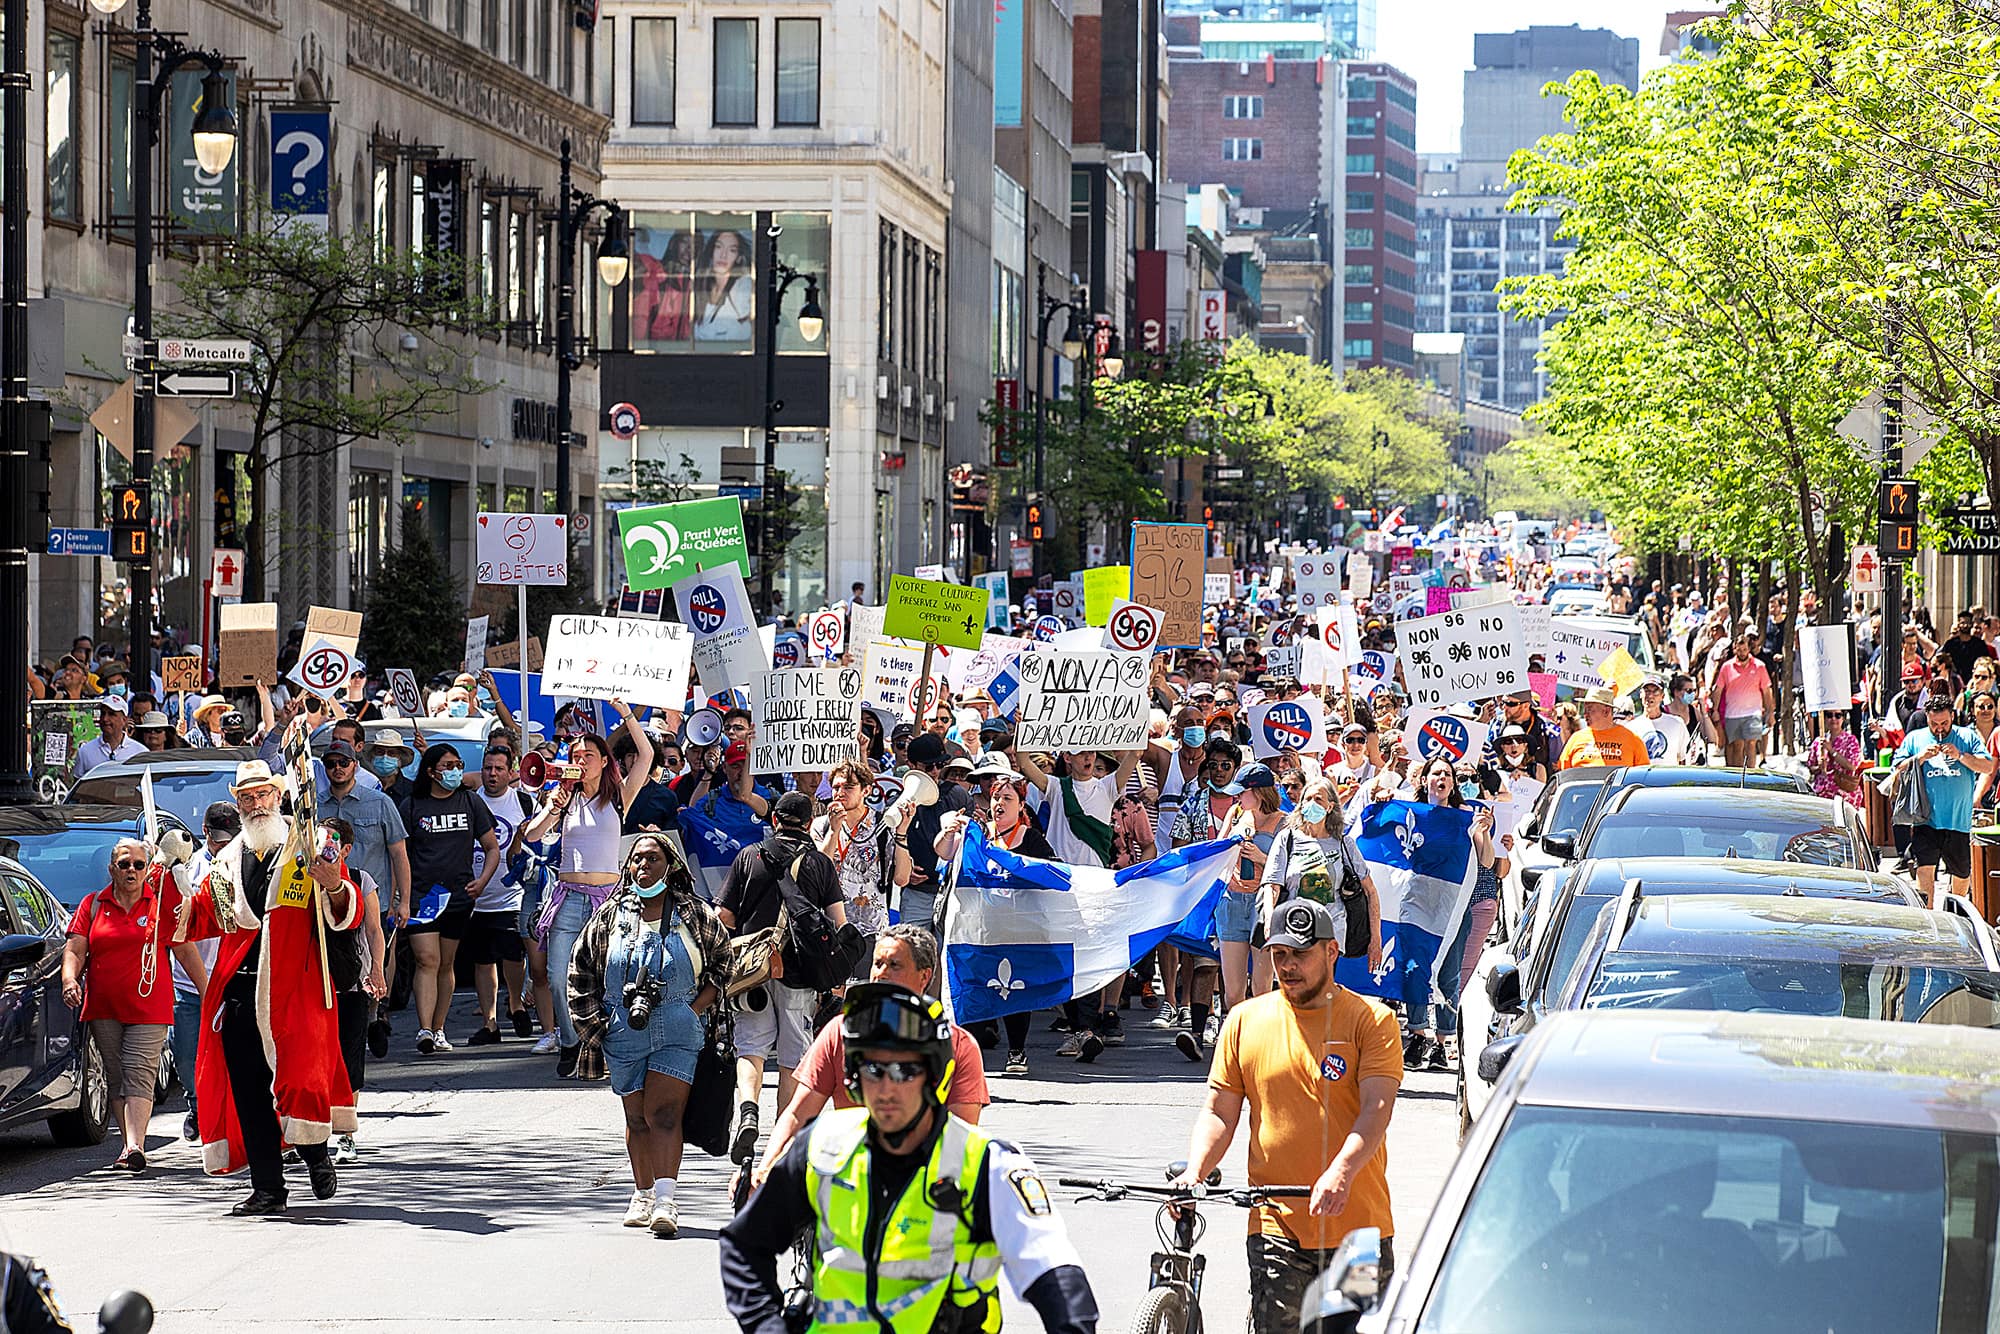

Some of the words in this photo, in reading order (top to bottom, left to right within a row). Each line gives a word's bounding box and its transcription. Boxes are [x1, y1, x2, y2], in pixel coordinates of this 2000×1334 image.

[184, 347, 246, 360] Metcalfe
[684, 530, 710, 542] Parti
[713, 524, 738, 537] Vert
[1137, 525, 1164, 552] I
[1165, 525, 1204, 551] GOT
[680, 542, 693, 551] du
[694, 536, 742, 552] Québec
[499, 562, 566, 582] BETTER
[1137, 553, 1192, 600] 96
[896, 580, 928, 594] VOTRE
[692, 589, 718, 607] BILL
[944, 600, 962, 612] SANS
[1135, 593, 1201, 621] PBLEMS
[1040, 619, 1060, 632] BILL
[1116, 613, 1151, 644] 96
[1444, 613, 1465, 628] 96
[1480, 617, 1503, 632] NO
[816, 621, 837, 642] 96
[1408, 627, 1440, 646] NON
[1551, 630, 1584, 647] CONTRE
[1585, 640, 1596, 650] LA
[491, 642, 537, 662] TEAH
[1478, 643, 1511, 660] NON
[167, 658, 199, 673] NON
[307, 654, 343, 684] 96
[881, 656, 888, 669] Is
[890, 656, 914, 673] there
[1042, 658, 1098, 690] NON
[1096, 653, 1119, 693] À
[1125, 659, 1144, 681] 96
[1421, 664, 1444, 679] NO
[184, 672, 200, 688] 96
[763, 673, 788, 700] LET
[795, 672, 826, 697] ME
[875, 675, 898, 687] room
[1450, 672, 1487, 691] NON
[1496, 670, 1515, 684] 96
[1572, 673, 1580, 682] LE
[394, 680, 417, 703] 96
[880, 690, 896, 703] ME
[897, 691, 906, 705] in
[1418, 689, 1440, 703] NO
[1022, 693, 1056, 722] LA
[1064, 691, 1141, 723] DIVISION
[1270, 708, 1306, 725] BILL
[763, 721, 789, 742] THE
[793, 721, 857, 741] LANGUAGE
[1020, 723, 1067, 748] DANS
[1273, 724, 1305, 749] 96
[1431, 719, 1464, 741] BILL
[755, 745, 785, 770] FOR
[776, 743, 796, 767] MY
[801, 742, 858, 765] EDUCATION
[1927, 767, 1962, 778] adidas
[431, 813, 468, 829] LIFE
[283, 889, 306, 901] NOW
[289, 882, 303, 891] ACT
[1327, 1055, 1345, 1070] BILL
